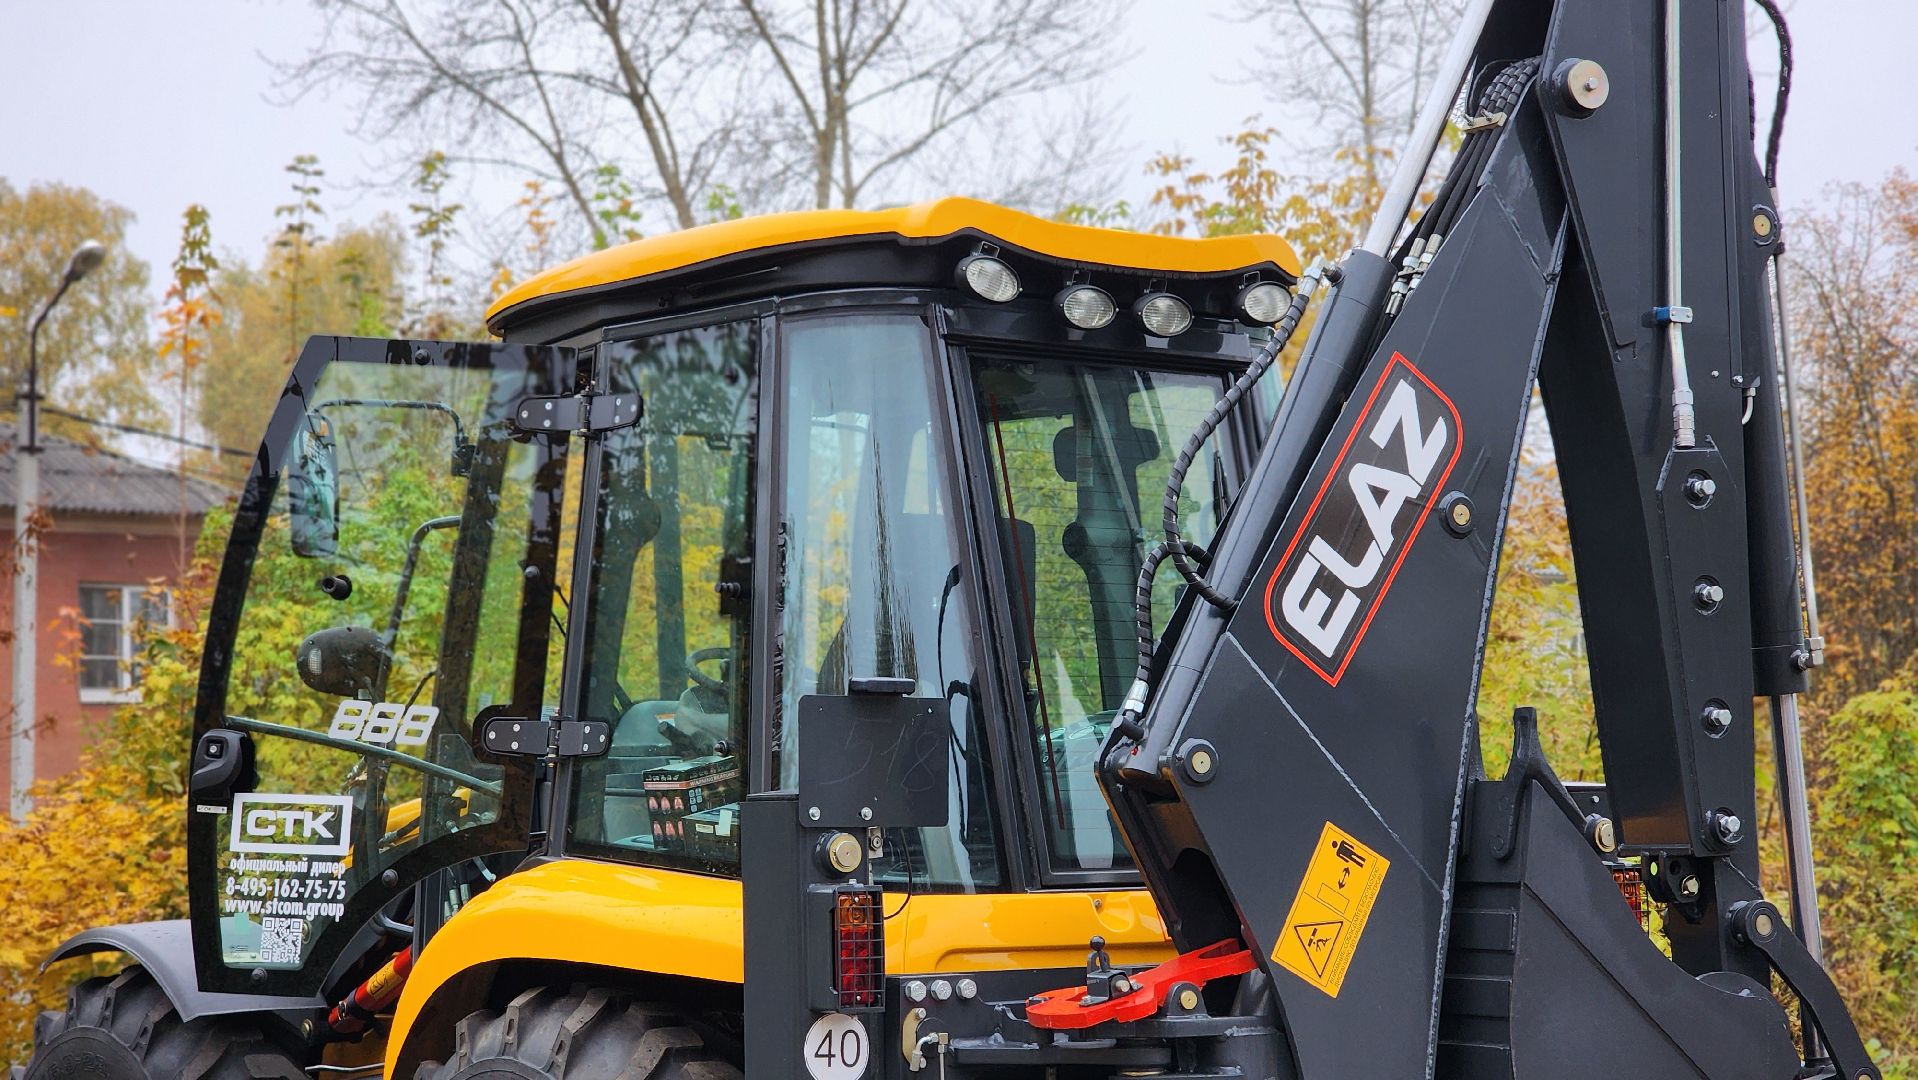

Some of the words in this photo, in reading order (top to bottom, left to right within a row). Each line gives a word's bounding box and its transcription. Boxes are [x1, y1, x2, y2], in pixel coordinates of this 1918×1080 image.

[1282, 379, 1447, 658] ELAZ
[328, 700, 440, 745] 888
[246, 809, 335, 838] СТК
[230, 853, 308, 875] официальный
[310, 861, 345, 879] дилер
[225, 876, 347, 899] 8-495-162-75-75
[225, 898, 345, 922] www.stcom.group
[814, 1029, 860, 1068] 40
